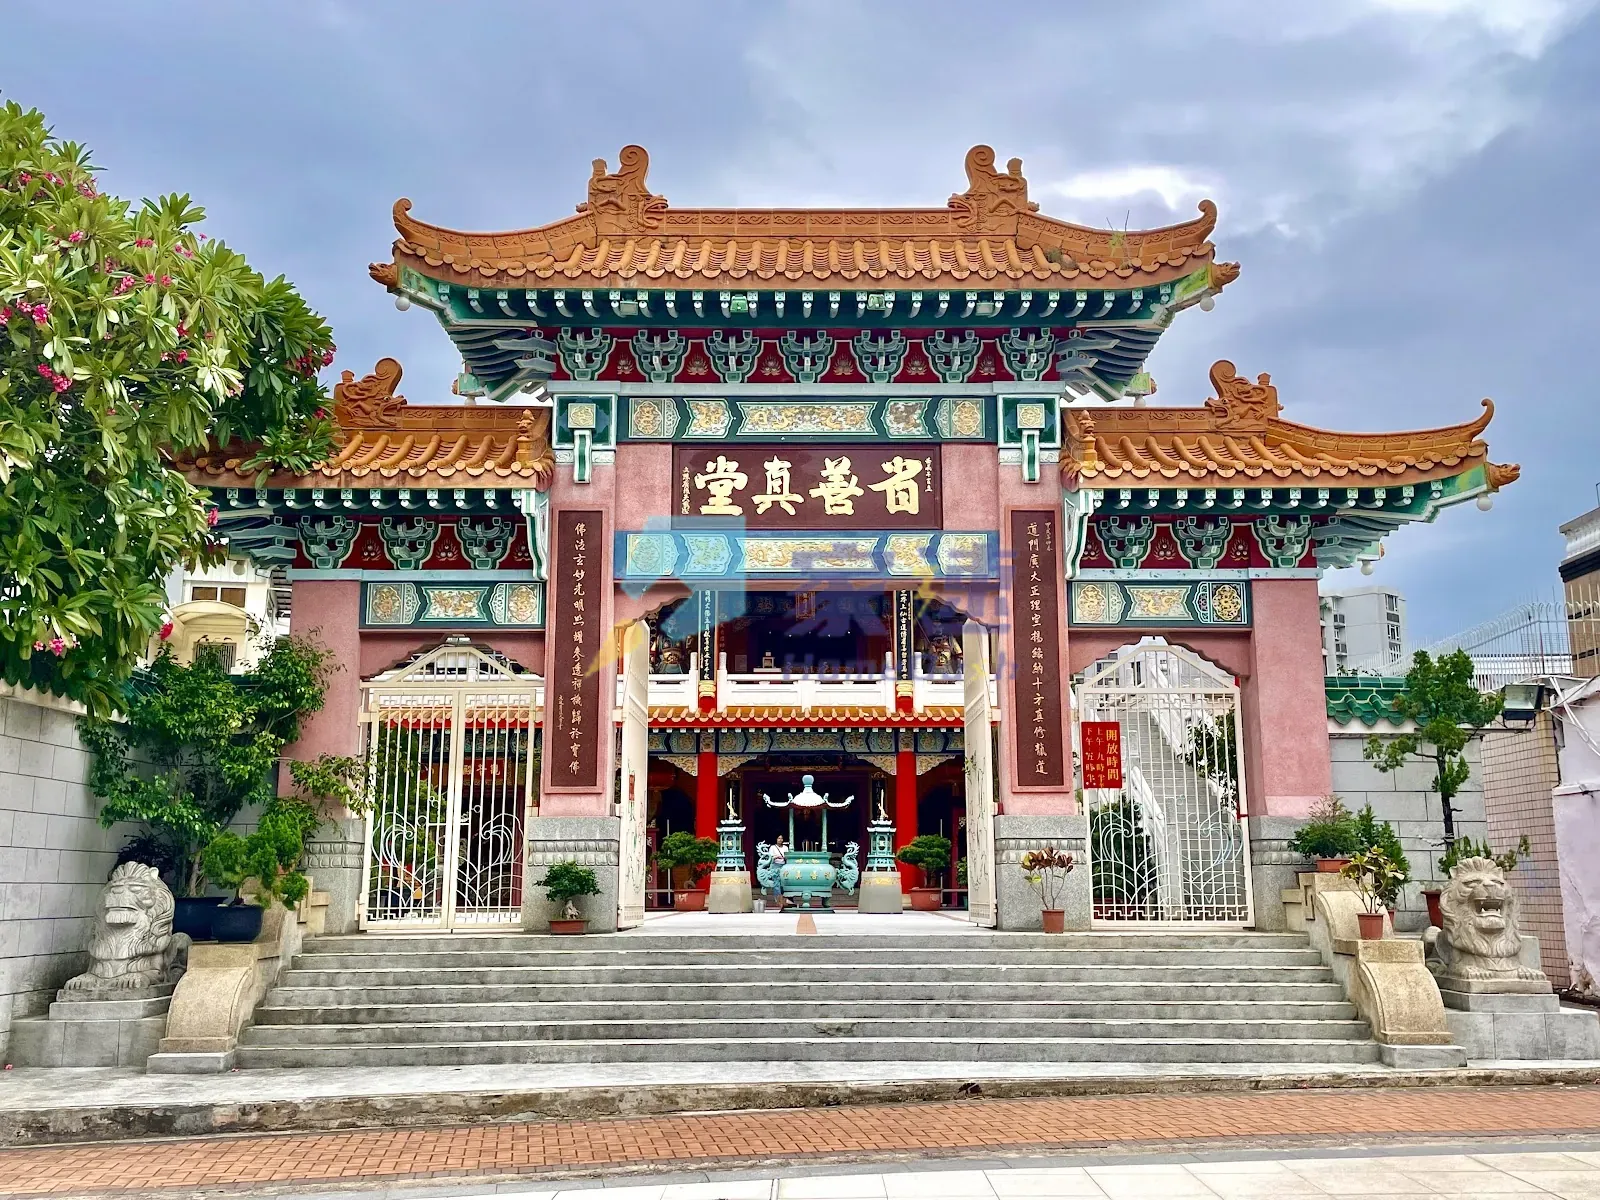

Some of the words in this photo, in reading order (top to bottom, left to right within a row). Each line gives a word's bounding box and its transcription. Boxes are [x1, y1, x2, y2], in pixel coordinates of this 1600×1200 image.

[694, 455, 924, 516] 省善真堂
[1106, 729, 1119, 781] 開放時間
